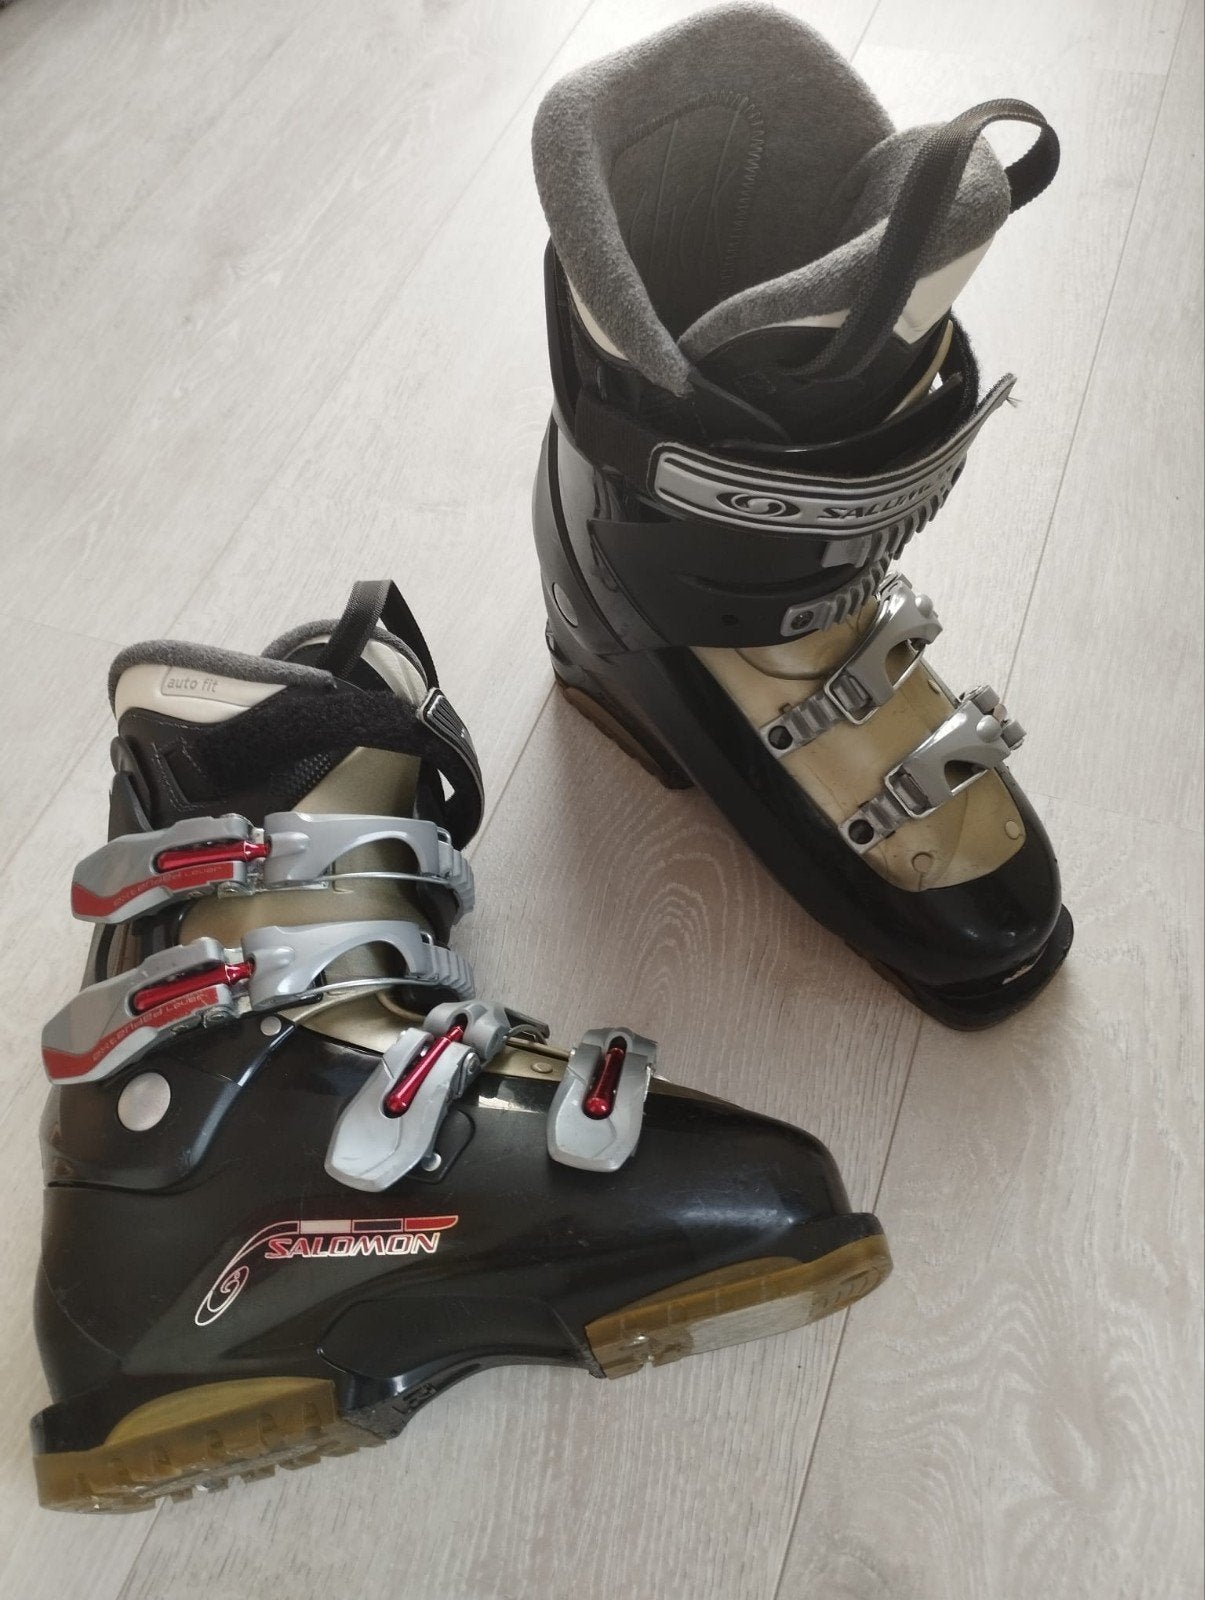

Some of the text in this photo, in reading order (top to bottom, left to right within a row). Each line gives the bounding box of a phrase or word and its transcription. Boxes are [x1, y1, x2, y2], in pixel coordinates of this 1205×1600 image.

[817, 484, 932, 519] SALOM
[167, 676, 219, 694] auto fit
[264, 1232, 441, 1259] SALOMON
